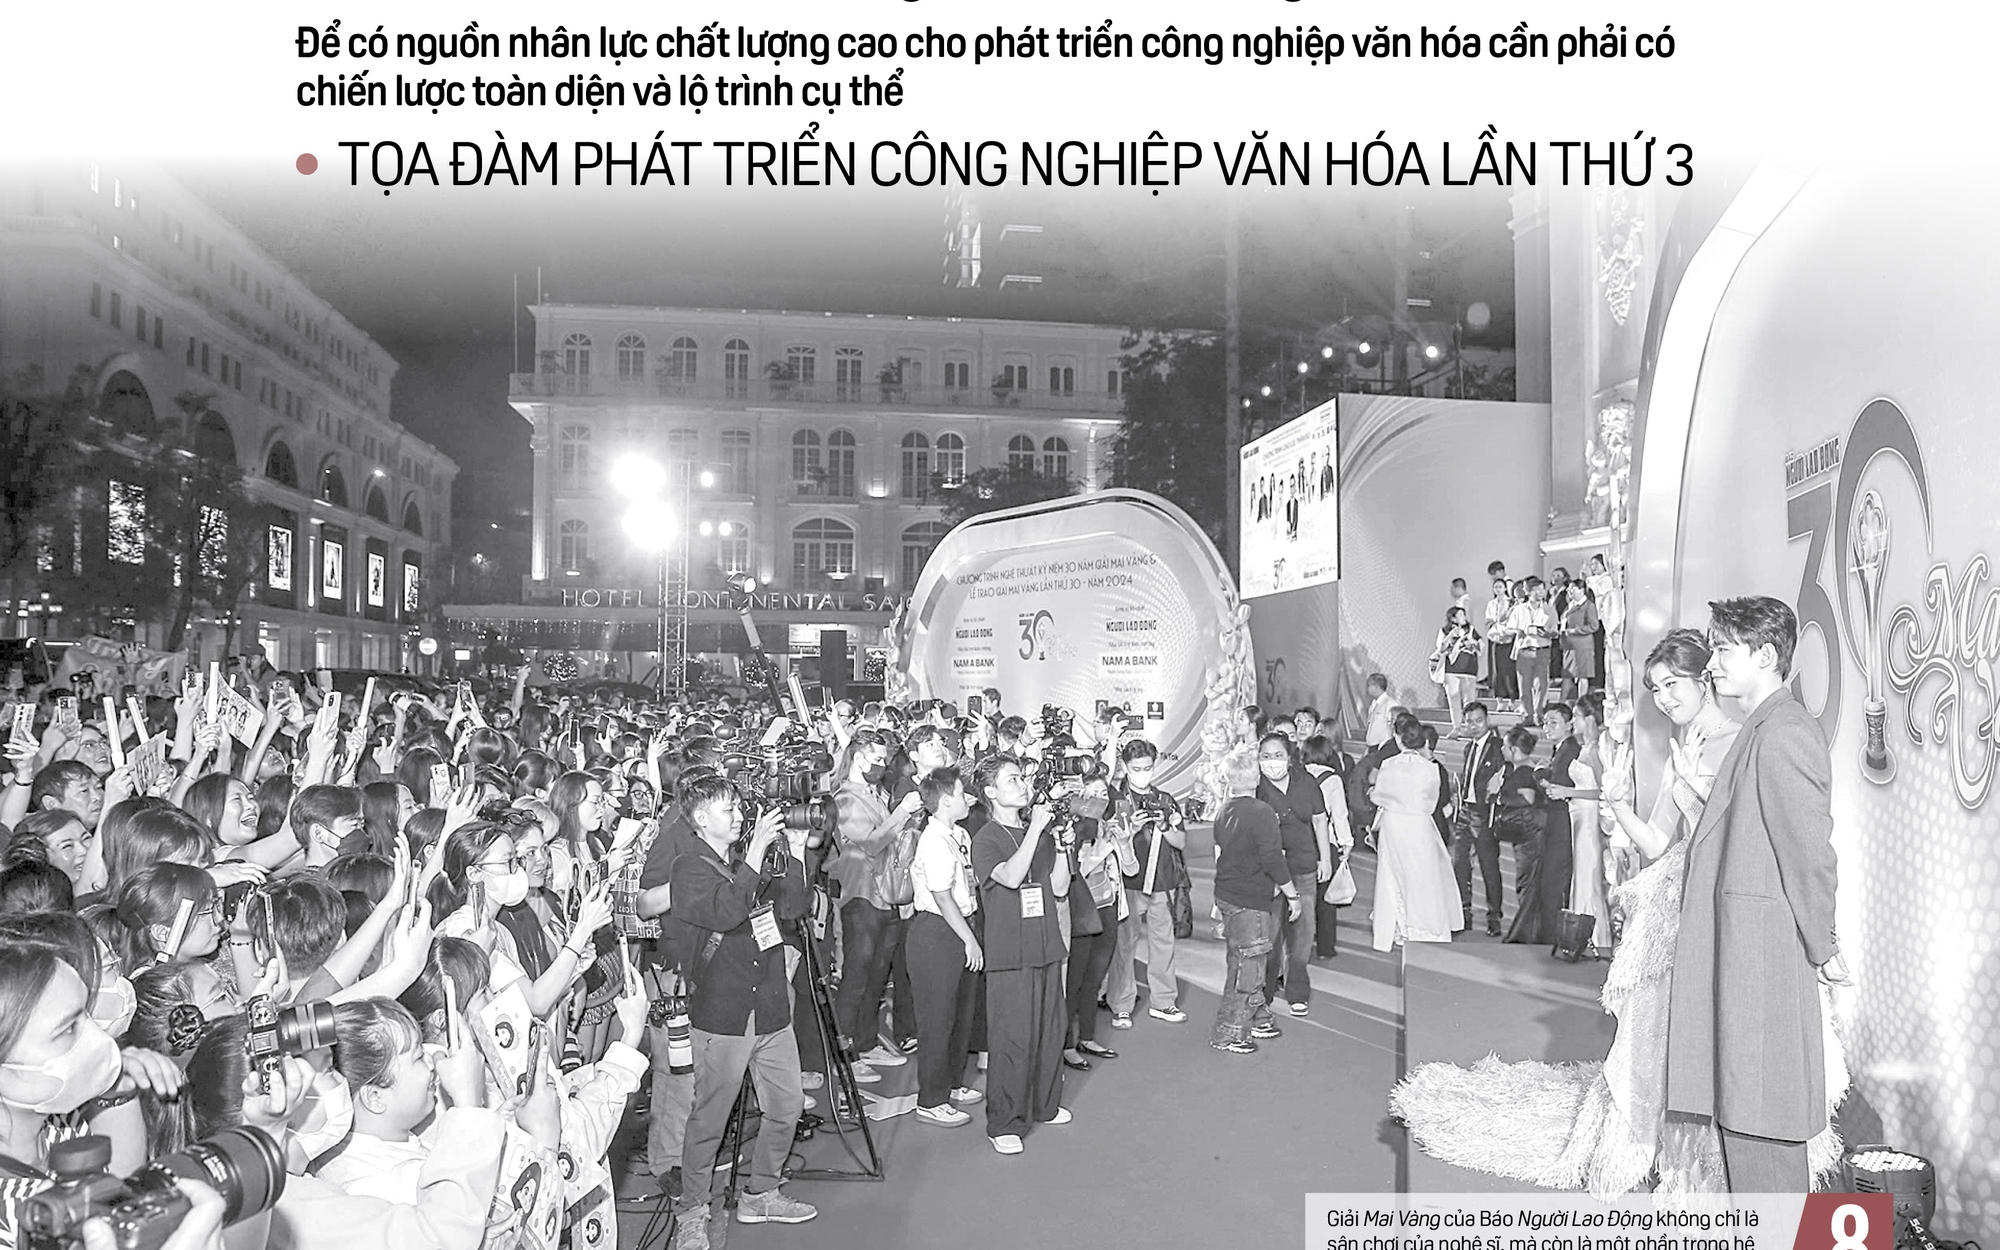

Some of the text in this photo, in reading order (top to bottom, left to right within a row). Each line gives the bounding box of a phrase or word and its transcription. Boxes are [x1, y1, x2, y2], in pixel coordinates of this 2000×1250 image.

[1806, 449, 1818, 477] LAO
[1065, 562, 1076, 573] 30
[1111, 558, 1124, 568] MAI
[1008, 585, 1020, 595] MAI
[1070, 578, 1081, 590] 30
[1106, 575, 1132, 587] 2024
[561, 588, 647, 608] HOTEL
[664, 590, 850, 611] ONTNENTAL
[954, 659, 969, 668] NAM
[976, 658, 994, 667] BANK
[1102, 656, 1158, 666] NAM A BANK
[1909, 1218, 1924, 1234] 54
